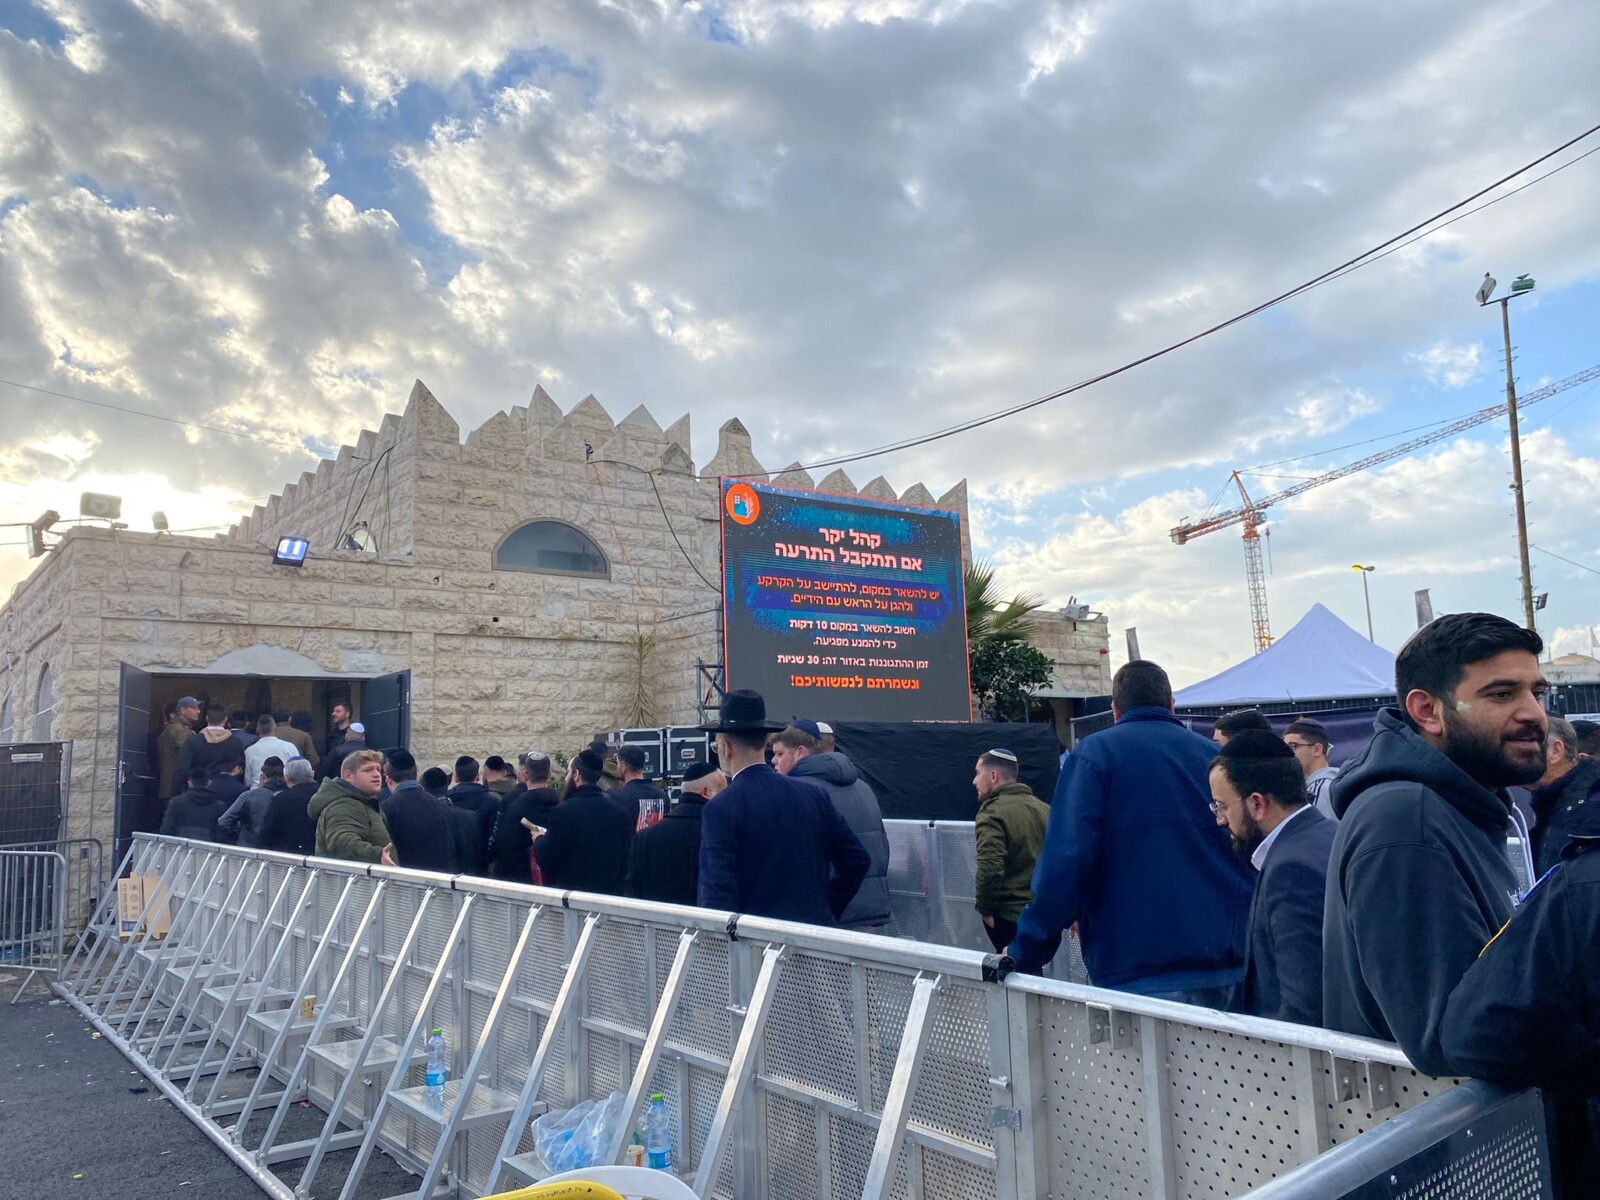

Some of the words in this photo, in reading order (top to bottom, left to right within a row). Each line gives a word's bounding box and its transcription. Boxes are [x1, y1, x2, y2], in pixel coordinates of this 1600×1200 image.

[819, 527, 844, 543] יקר
[849, 528, 881, 548] קהל
[775, 542, 836, 562] התרעה
[839, 547, 897, 568] תתקבל
[901, 556, 922, 571] אם
[757, 575, 794, 587] הקרקע
[797, 577, 811, 588] על
[814, 581, 857, 593] להתיישב
[859, 585, 891, 596] במקום,
[791, 593, 824, 605] הידיים.
[893, 588, 927, 599] להשאר
[929, 591, 940, 600] יש
[826, 596, 841, 606] עם
[843, 598, 872, 608] הראש
[874, 598, 888, 609] על
[890, 600, 913, 611] ולהגן
[789, 619, 814, 630] דקות
[816, 620, 828, 630] 10
[830, 621, 858, 632] במקום
[861, 623, 892, 634] להשאר
[894, 625, 916, 635] חשוב
[813, 636, 849, 647] מפגיעה.
[851, 638, 881, 648] להמנע
[882, 640, 897, 649] כדי
[776, 654, 805, 665] שניות
[807, 655, 820, 665] 30
[822, 656, 837, 665] זה:
[839, 657, 866, 666] באזור
[868, 658, 914, 669] ההתגוננות
[916, 660, 929, 670] זמן
[790, 674, 863, 688] לנפשותיכם!
[866, 678, 920, 690] ונשמרתם
